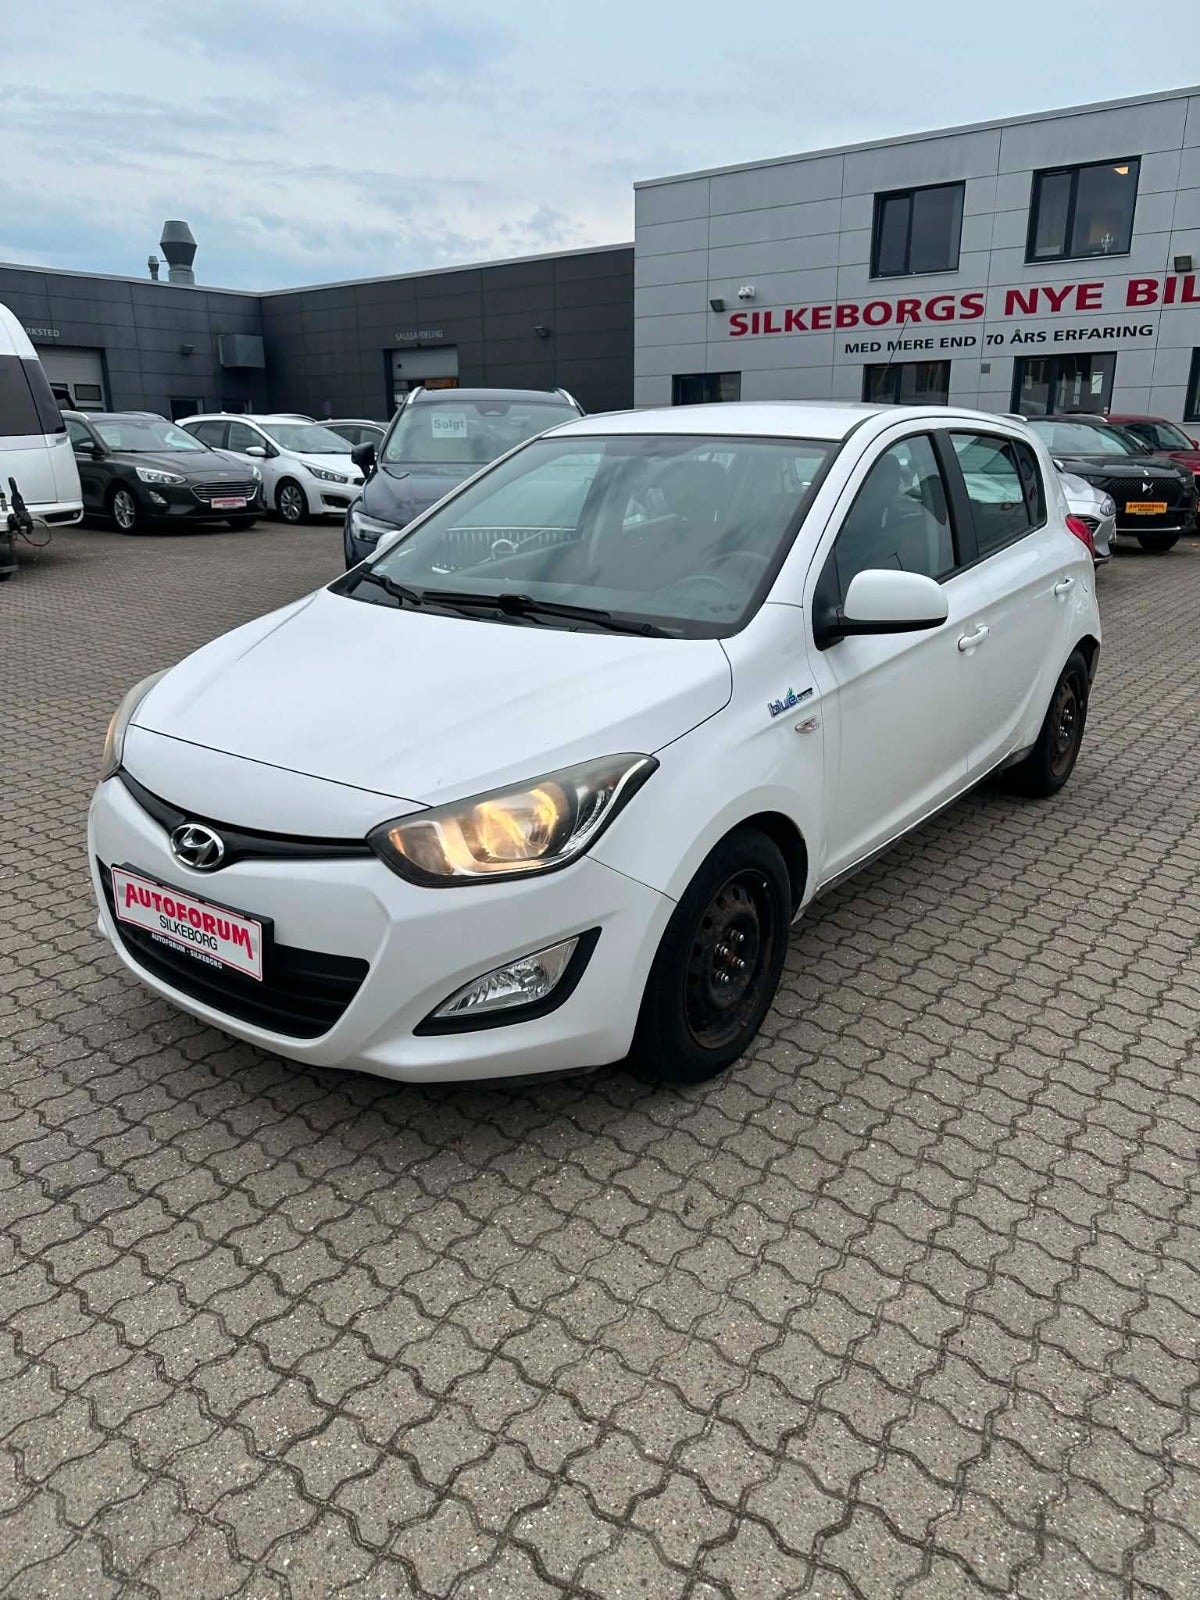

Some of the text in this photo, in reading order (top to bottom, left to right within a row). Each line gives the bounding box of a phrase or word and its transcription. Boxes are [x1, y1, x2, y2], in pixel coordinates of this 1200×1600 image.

[729, 275, 1200, 336] SILKEBORGS NYE BIL
[26, 327, 60, 337] RKSTED
[845, 325, 1153, 353] MED MERE END 70 ÅRS ERFARING
[433, 419, 464, 431] Solgt
[126, 883, 253, 960] AUTOFORUM
[160, 915, 217, 951] SILKEBORG
[151, 933, 186, 953] AUTOFORUM
[190, 949, 223, 969] SILKEBORG
